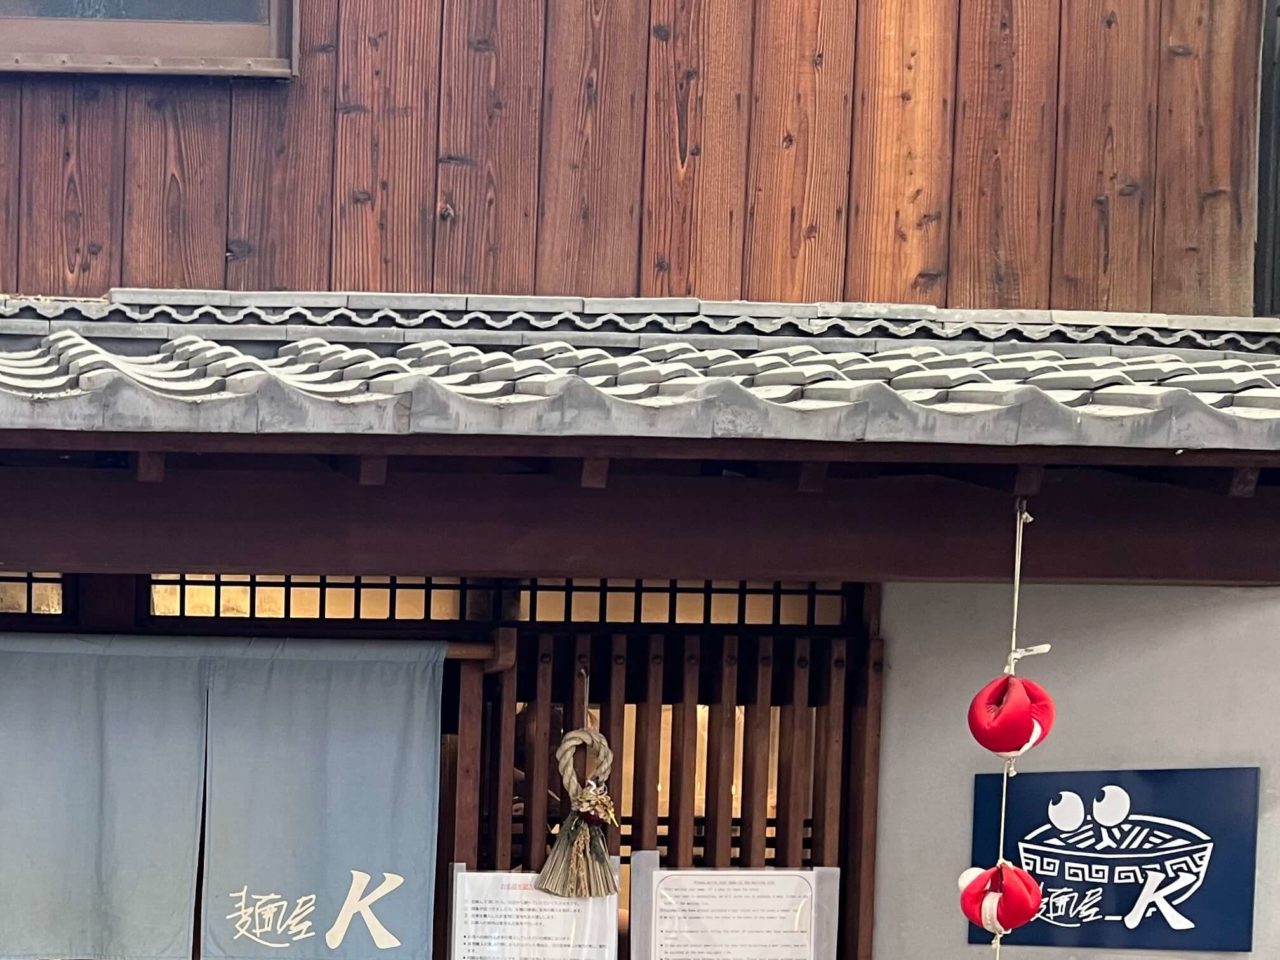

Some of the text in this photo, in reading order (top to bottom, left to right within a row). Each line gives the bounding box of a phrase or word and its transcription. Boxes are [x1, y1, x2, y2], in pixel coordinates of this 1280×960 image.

[226, 885, 317, 948] 麺屋
[325, 869, 405, 950] K
[1123, 870, 1198, 930] K
